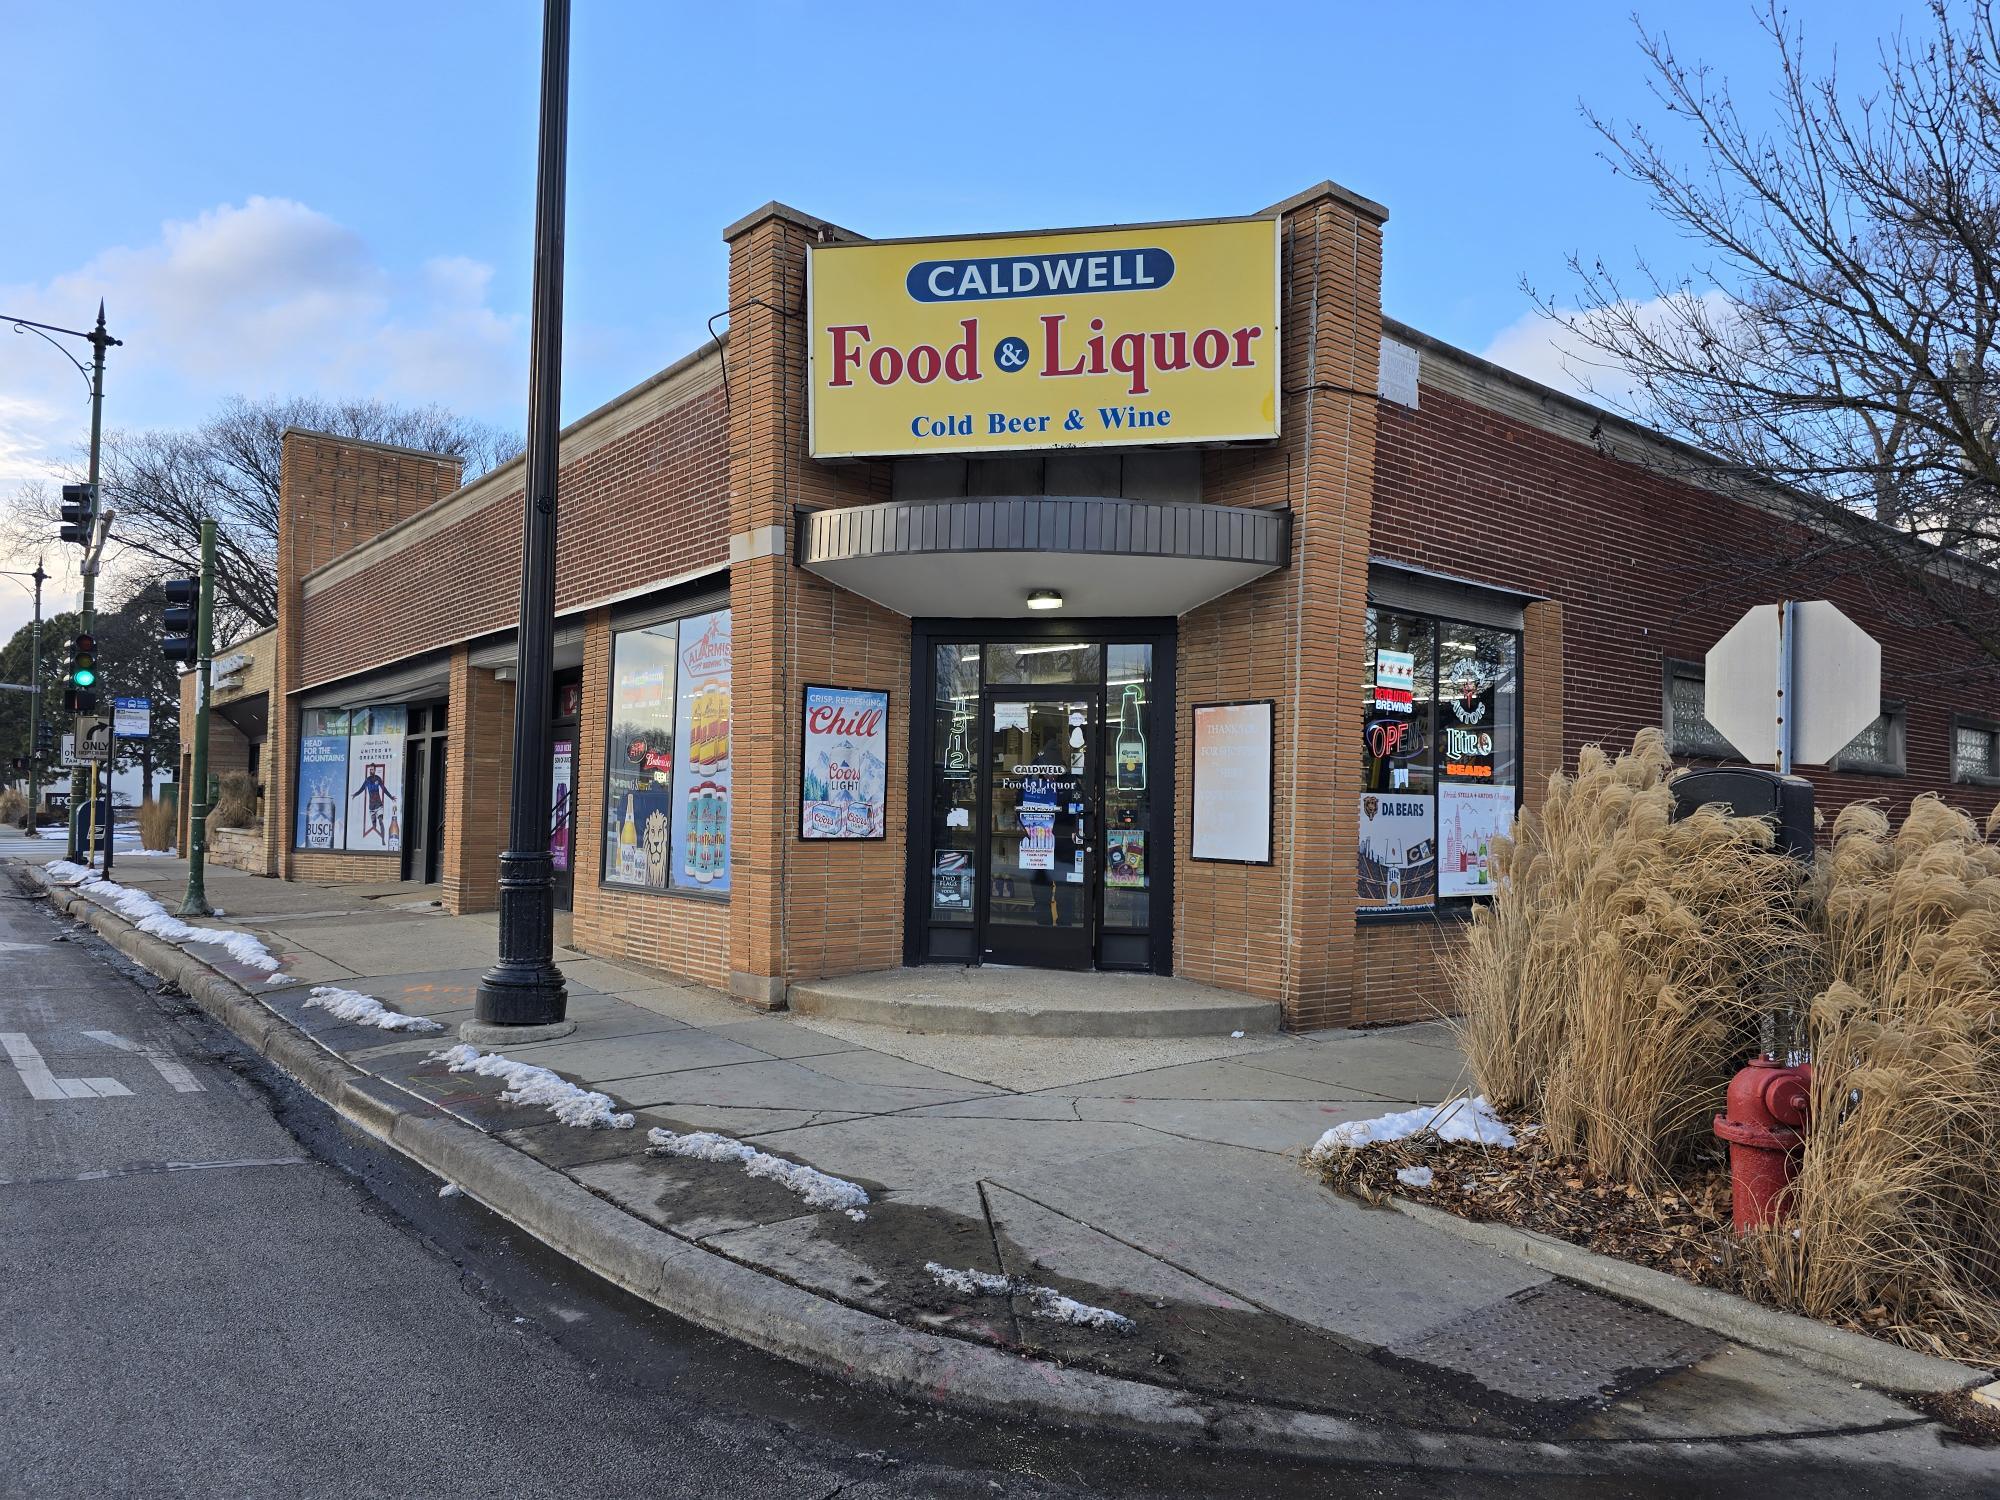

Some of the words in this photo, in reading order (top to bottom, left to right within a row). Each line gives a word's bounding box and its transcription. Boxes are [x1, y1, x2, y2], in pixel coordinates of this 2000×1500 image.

[927, 254, 1155, 297] CALDWELL
[827, 317, 982, 388] Food
[1000, 343, 1027, 368] &
[1040, 314, 1262, 395] Liquor
[911, 414, 973, 438] Cold
[987, 411, 1051, 435] Beer
[1063, 408, 1085, 431] &
[1097, 405, 1172, 430] Wine
[689, 642, 732, 666] ALARMIS
[809, 694, 834, 705] CRISP.
[1374, 687, 1413, 703] REVOLUTION
[1375, 699, 1413, 714] BREWING
[1450, 699, 1486, 725] ARTOIS
[809, 705, 883, 738] Chill
[82, 741, 109, 751] ONLY
[304, 739, 322, 747] HEAD
[1373, 721, 1420, 758] OPEN
[1446, 728, 1478, 760] Lite
[319, 746, 331, 755] THE
[303, 754, 345, 763] MOUNTAINS
[829, 762, 860, 780] Coors
[1015, 766, 1063, 774] CALDWELL
[1446, 763, 1492, 777] BEARS
[831, 780, 859, 791] LIGHT
[1002, 778, 1029, 790] Food
[1039, 778, 1076, 793] Liquor
[1025, 785, 1047, 795] Open
[1382, 802, 1395, 816] DA
[1395, 802, 1424, 817] BEARS
[814, 812, 834, 826] Coors
[306, 823, 334, 836] BUSCH
